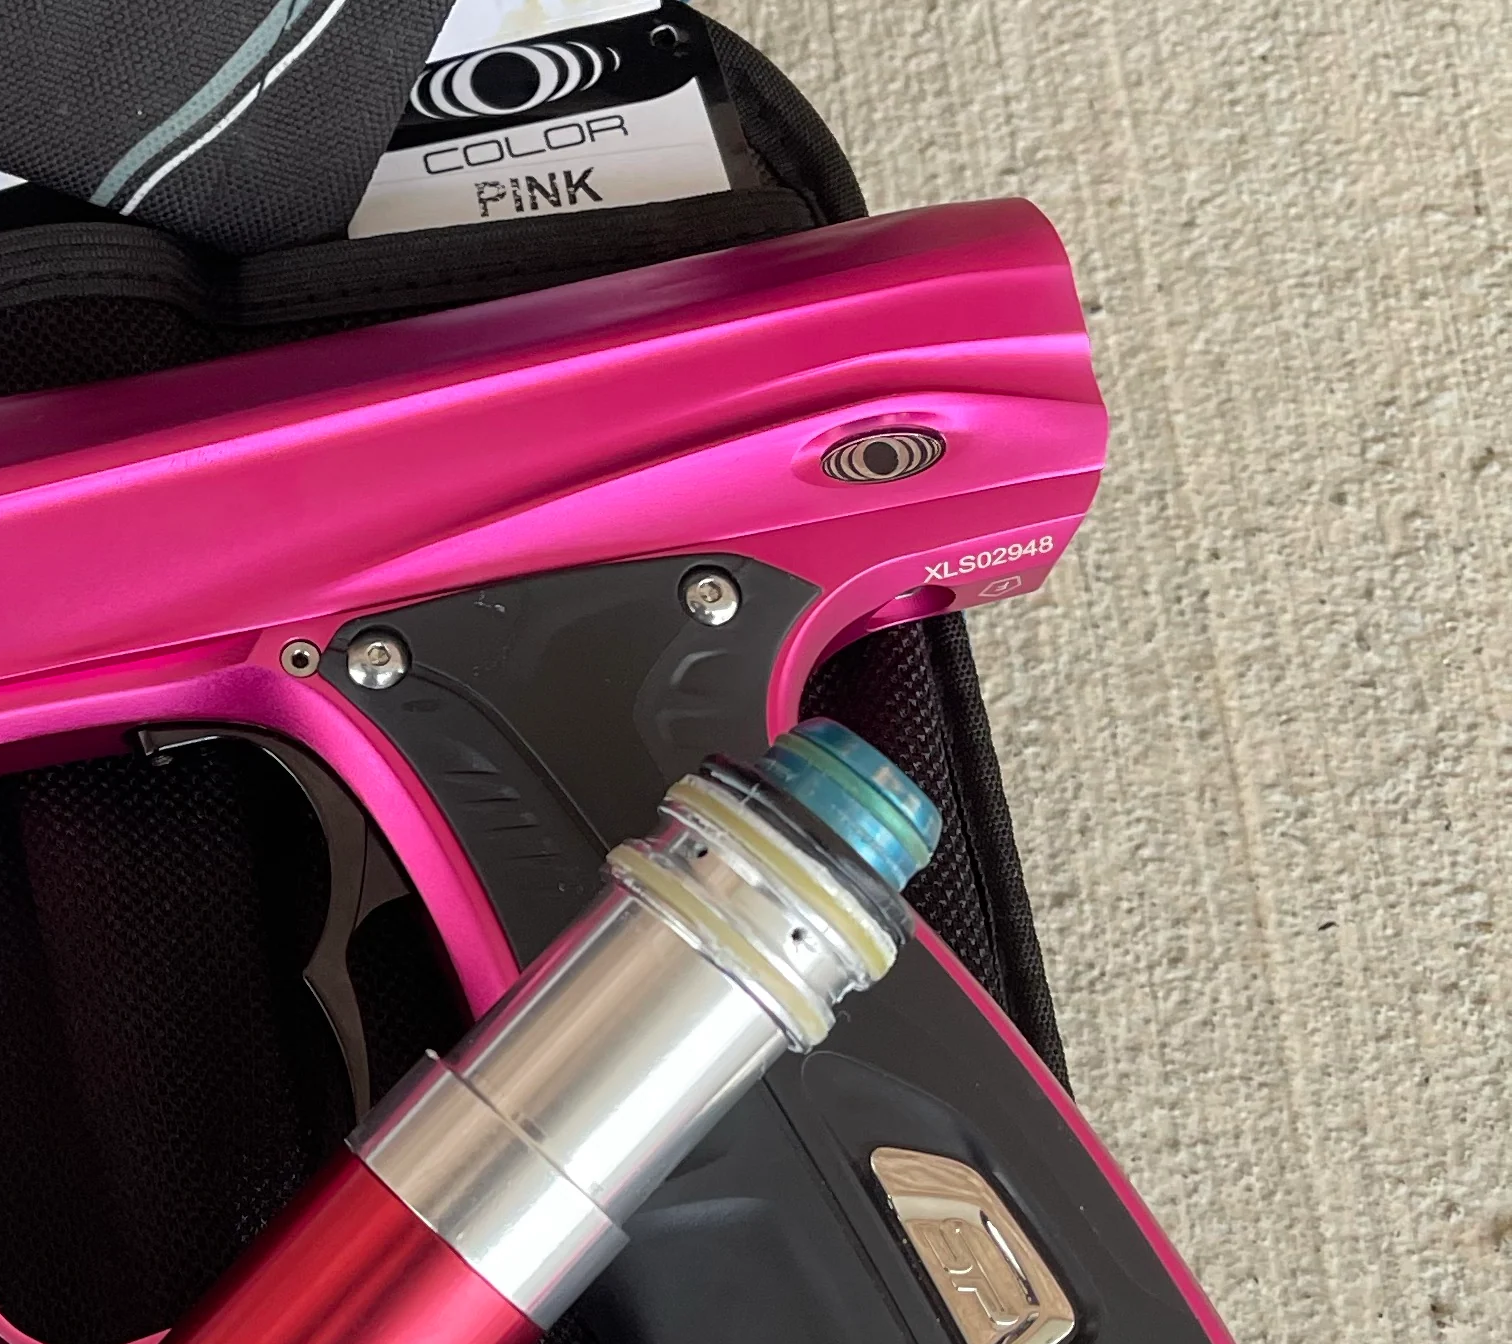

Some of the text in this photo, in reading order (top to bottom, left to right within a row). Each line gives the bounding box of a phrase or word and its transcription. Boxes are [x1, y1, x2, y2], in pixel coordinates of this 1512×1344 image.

[423, 114, 629, 175] COLOR
[475, 166, 604, 218] PINK
[923, 535, 1054, 583] XLS02948
